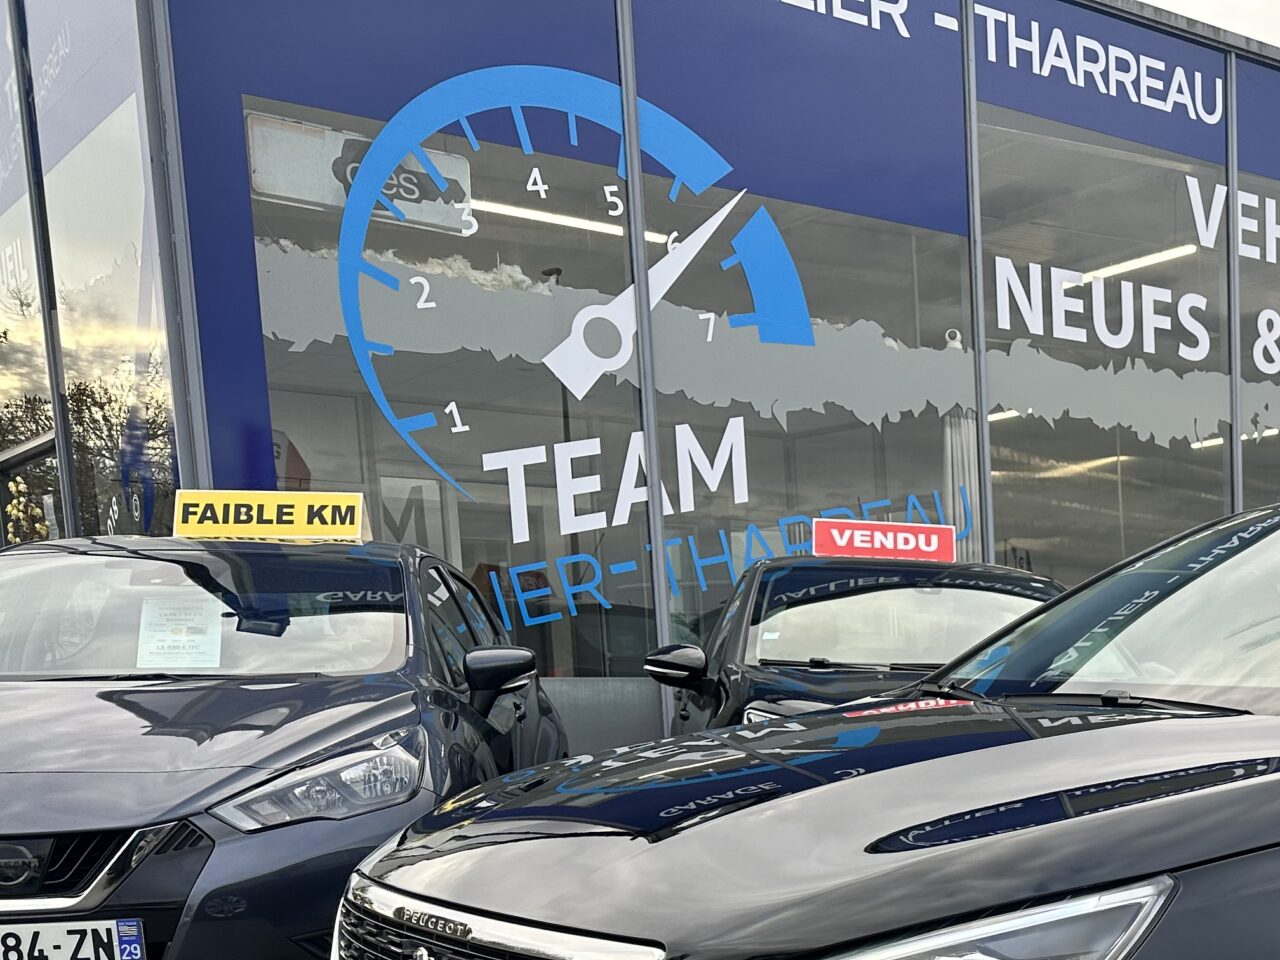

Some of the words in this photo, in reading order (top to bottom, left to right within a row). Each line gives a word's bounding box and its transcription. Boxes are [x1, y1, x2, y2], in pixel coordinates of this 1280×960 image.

[974, 3, 1222, 125] THARREAU
[526, 167, 549, 199] 4
[603, 185, 624, 216] 5
[453, 202, 479, 236] 3
[409, 276, 437, 309] 2
[994, 256, 1210, 362] NEUFS
[699, 312, 716, 342] 7
[444, 401, 470, 433] 1
[482, 416, 749, 544] TEAM
[181, 503, 295, 526] FAIBLE
[306, 504, 356, 526] KM
[829, 528, 940, 552] VENDU
[403, 908, 465, 936] PEUGEOT
[121, 943, 141, 960] 29
